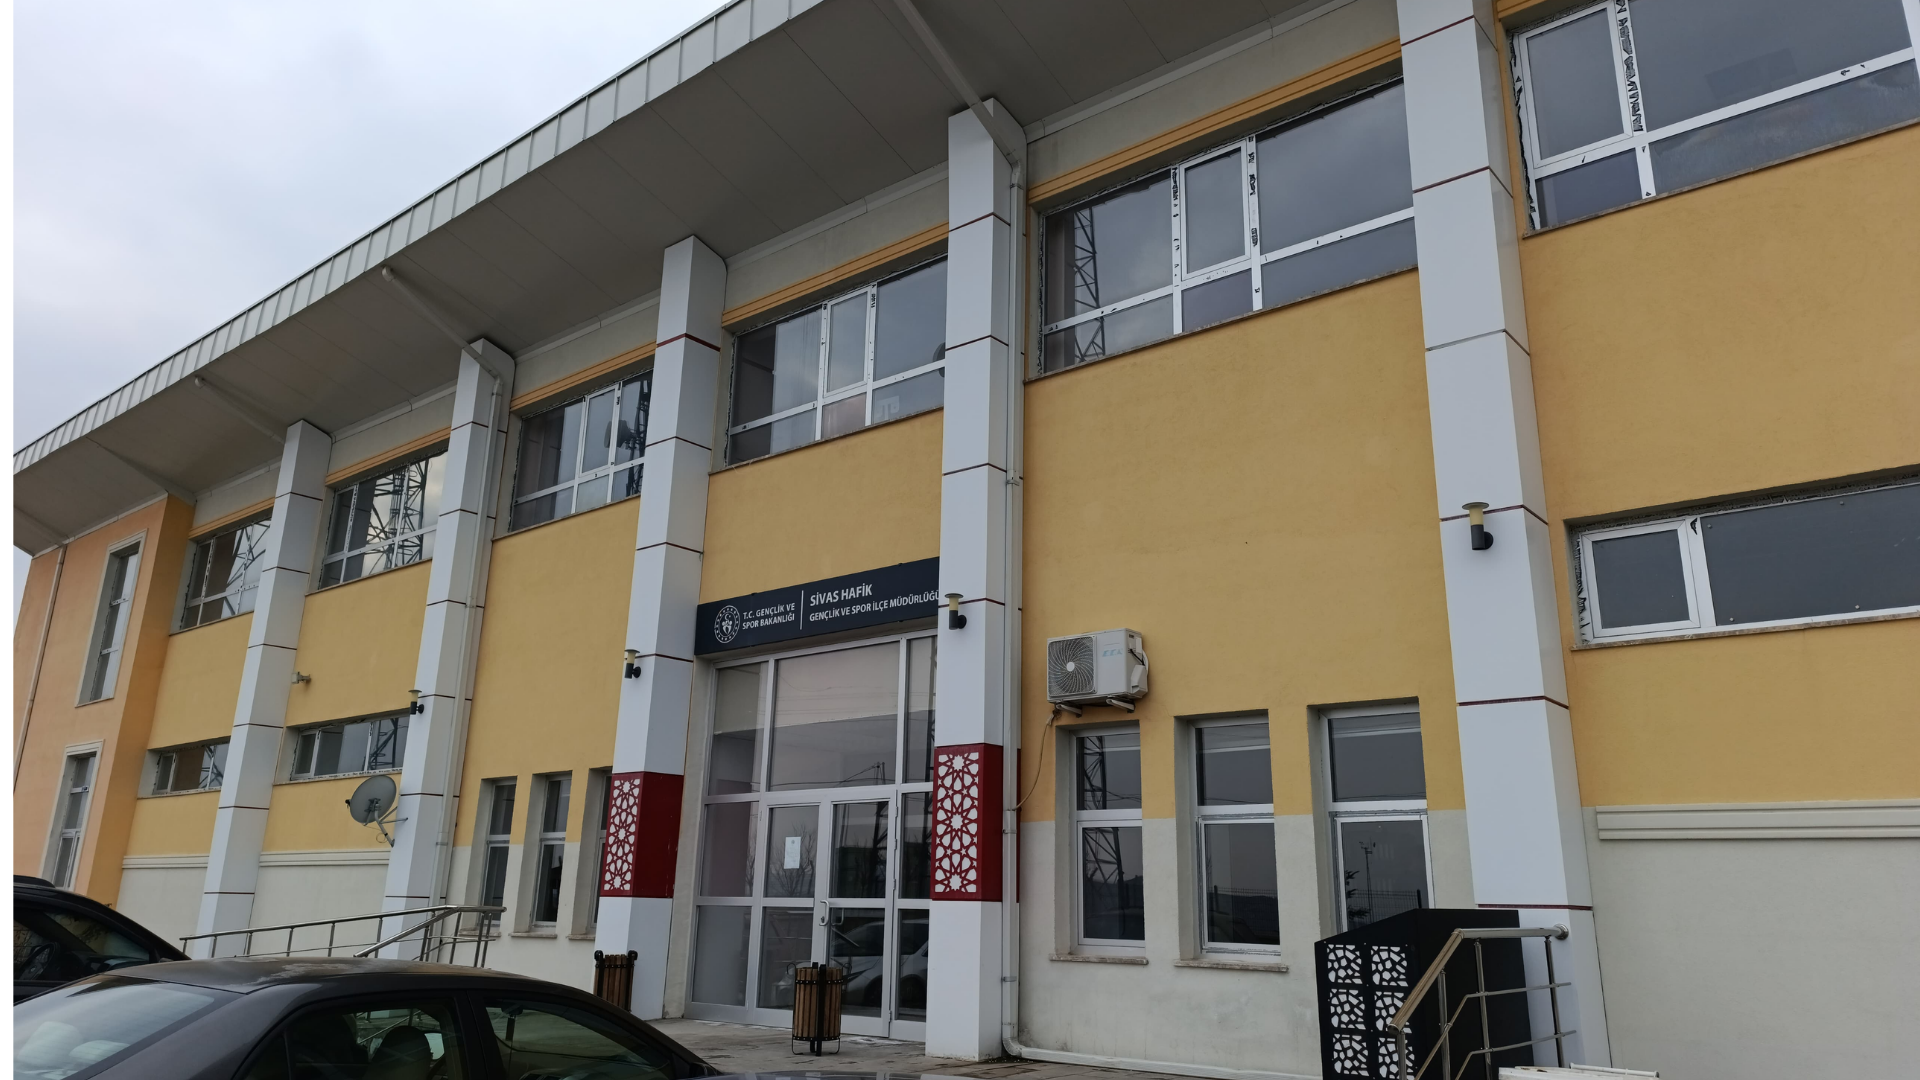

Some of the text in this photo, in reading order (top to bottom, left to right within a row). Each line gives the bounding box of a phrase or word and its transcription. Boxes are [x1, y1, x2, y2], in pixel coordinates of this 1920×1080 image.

[810, 583, 872, 606] SİVAS HAFİK
[742, 612, 794, 630] SPOR BAKANLIĞI
[743, 602, 796, 620] T.C. GENÇLİK VE
[810, 608, 840, 622] GENÇLİK
[841, 606, 850, 616] VE
[852, 603, 872, 614] SPOR
[872, 600, 888, 612] İLÇE
